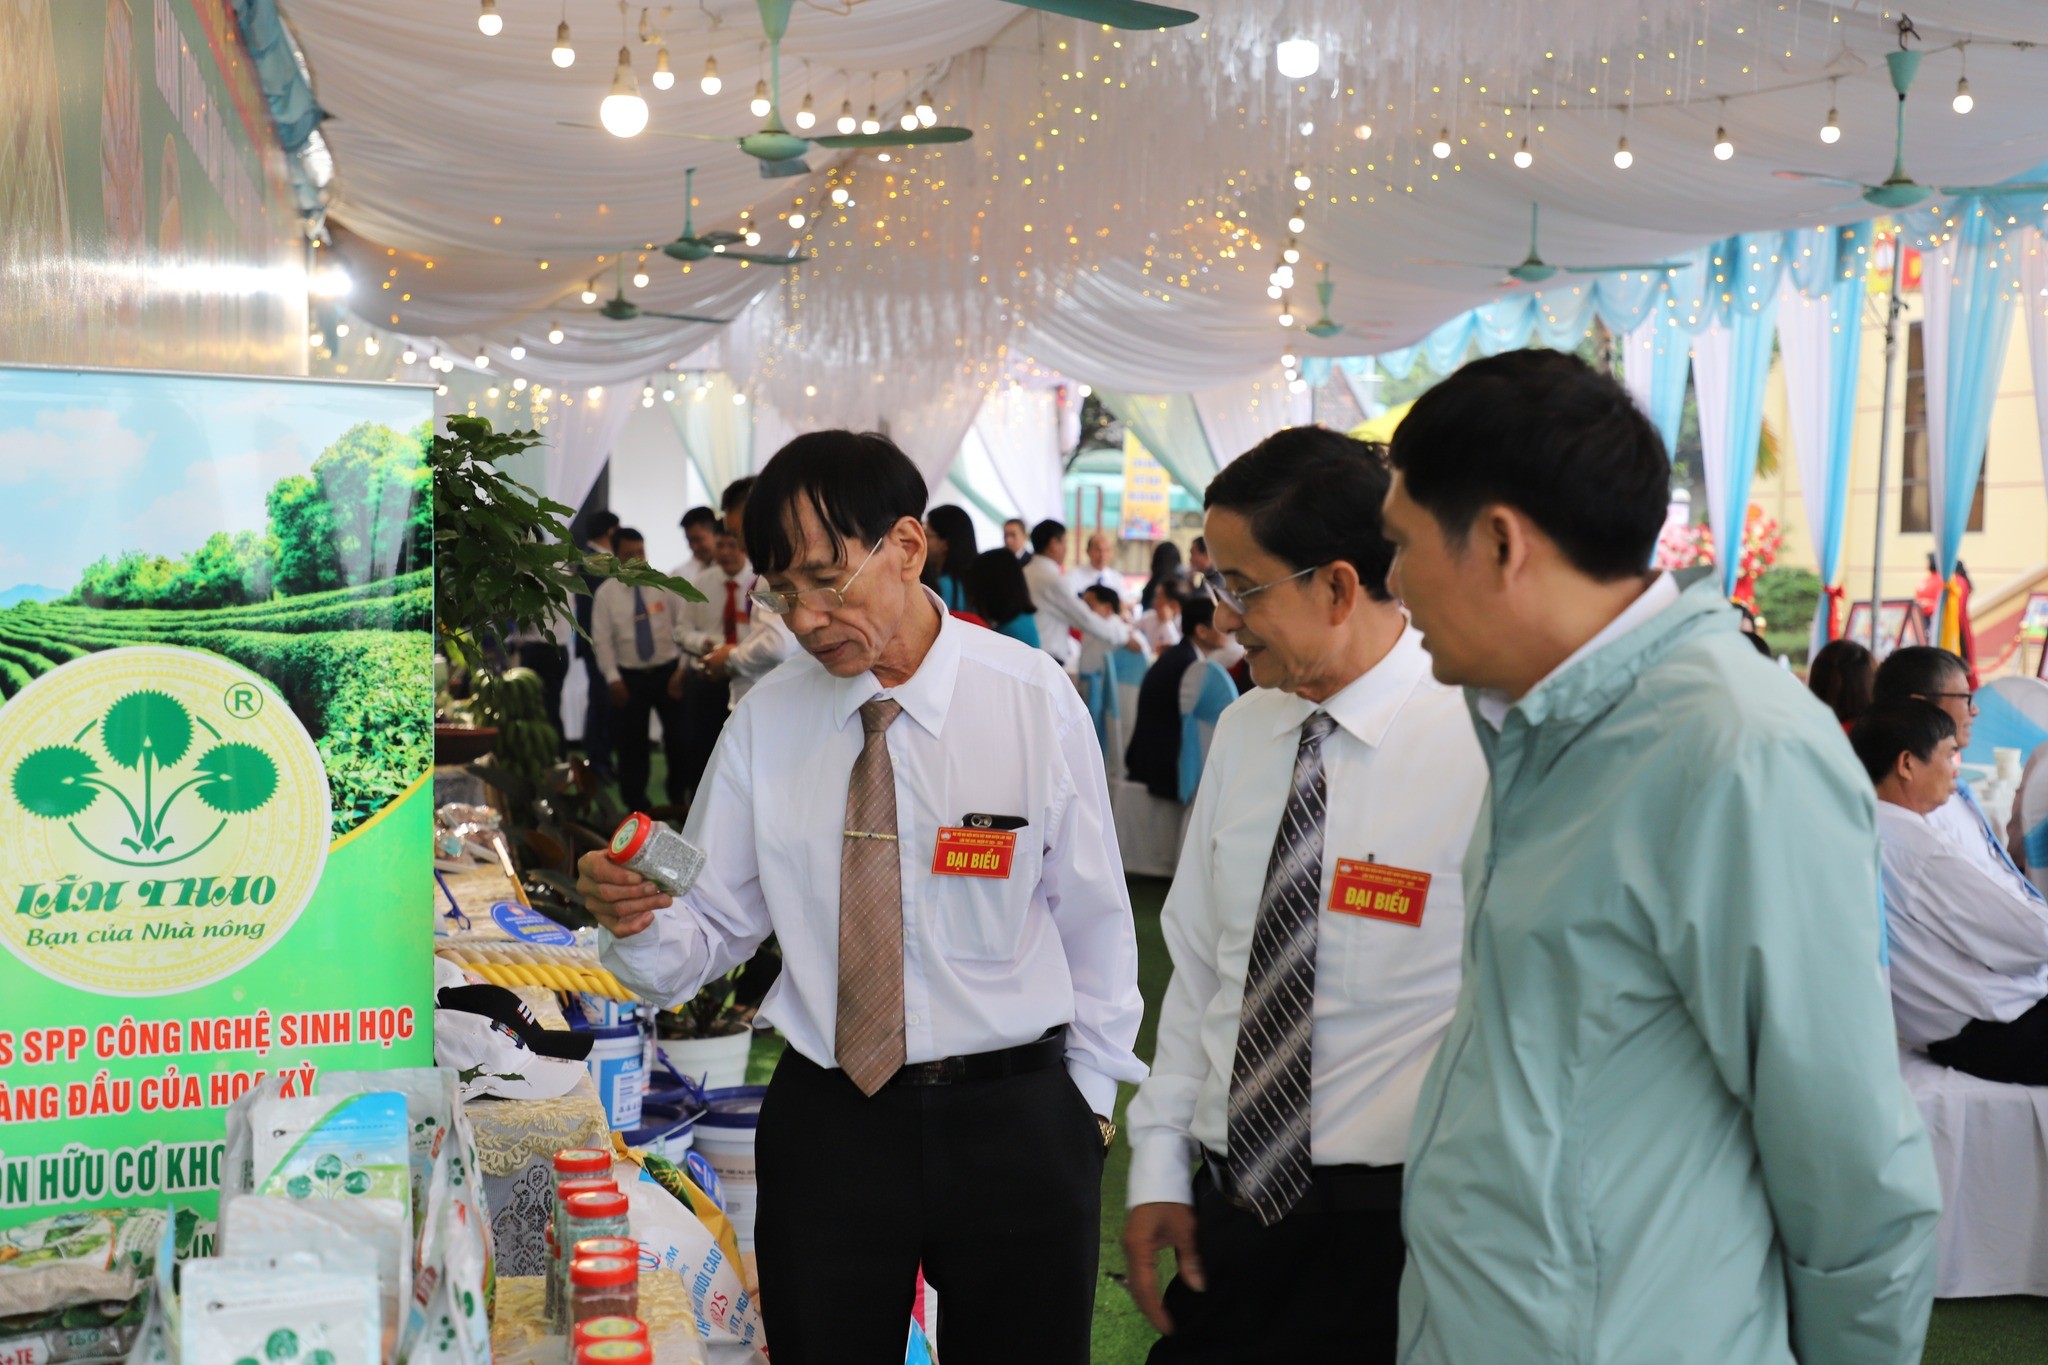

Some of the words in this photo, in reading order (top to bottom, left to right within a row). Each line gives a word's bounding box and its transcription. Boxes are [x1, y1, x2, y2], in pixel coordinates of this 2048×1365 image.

[946, 851, 969, 871] ĐẠI
[970, 848, 1000, 870] BIỂU
[15, 874, 130, 919] LÂM
[138, 875, 276, 908] THAO
[1344, 886, 1372, 910] ĐẠI
[1373, 889, 1410, 915] BIỂU
[26, 928, 78, 949] Bạn
[87, 923, 133, 942] của
[141, 921, 194, 940] Nhà
[202, 919, 265, 940] nông
[24, 1028, 86, 1063] SPP
[97, 1018, 181, 1058] CÔNG
[191, 1010, 270, 1054] NGHỆ
[280, 1012, 350, 1046] SINH
[360, 1007, 413, 1046] HỌC
[68, 1071, 130, 1116] ĐẦU
[141, 1067, 202, 1111] CỦA
[39, 1148, 104, 1199] HỮU
[115, 1145, 158, 1193] CƠ
